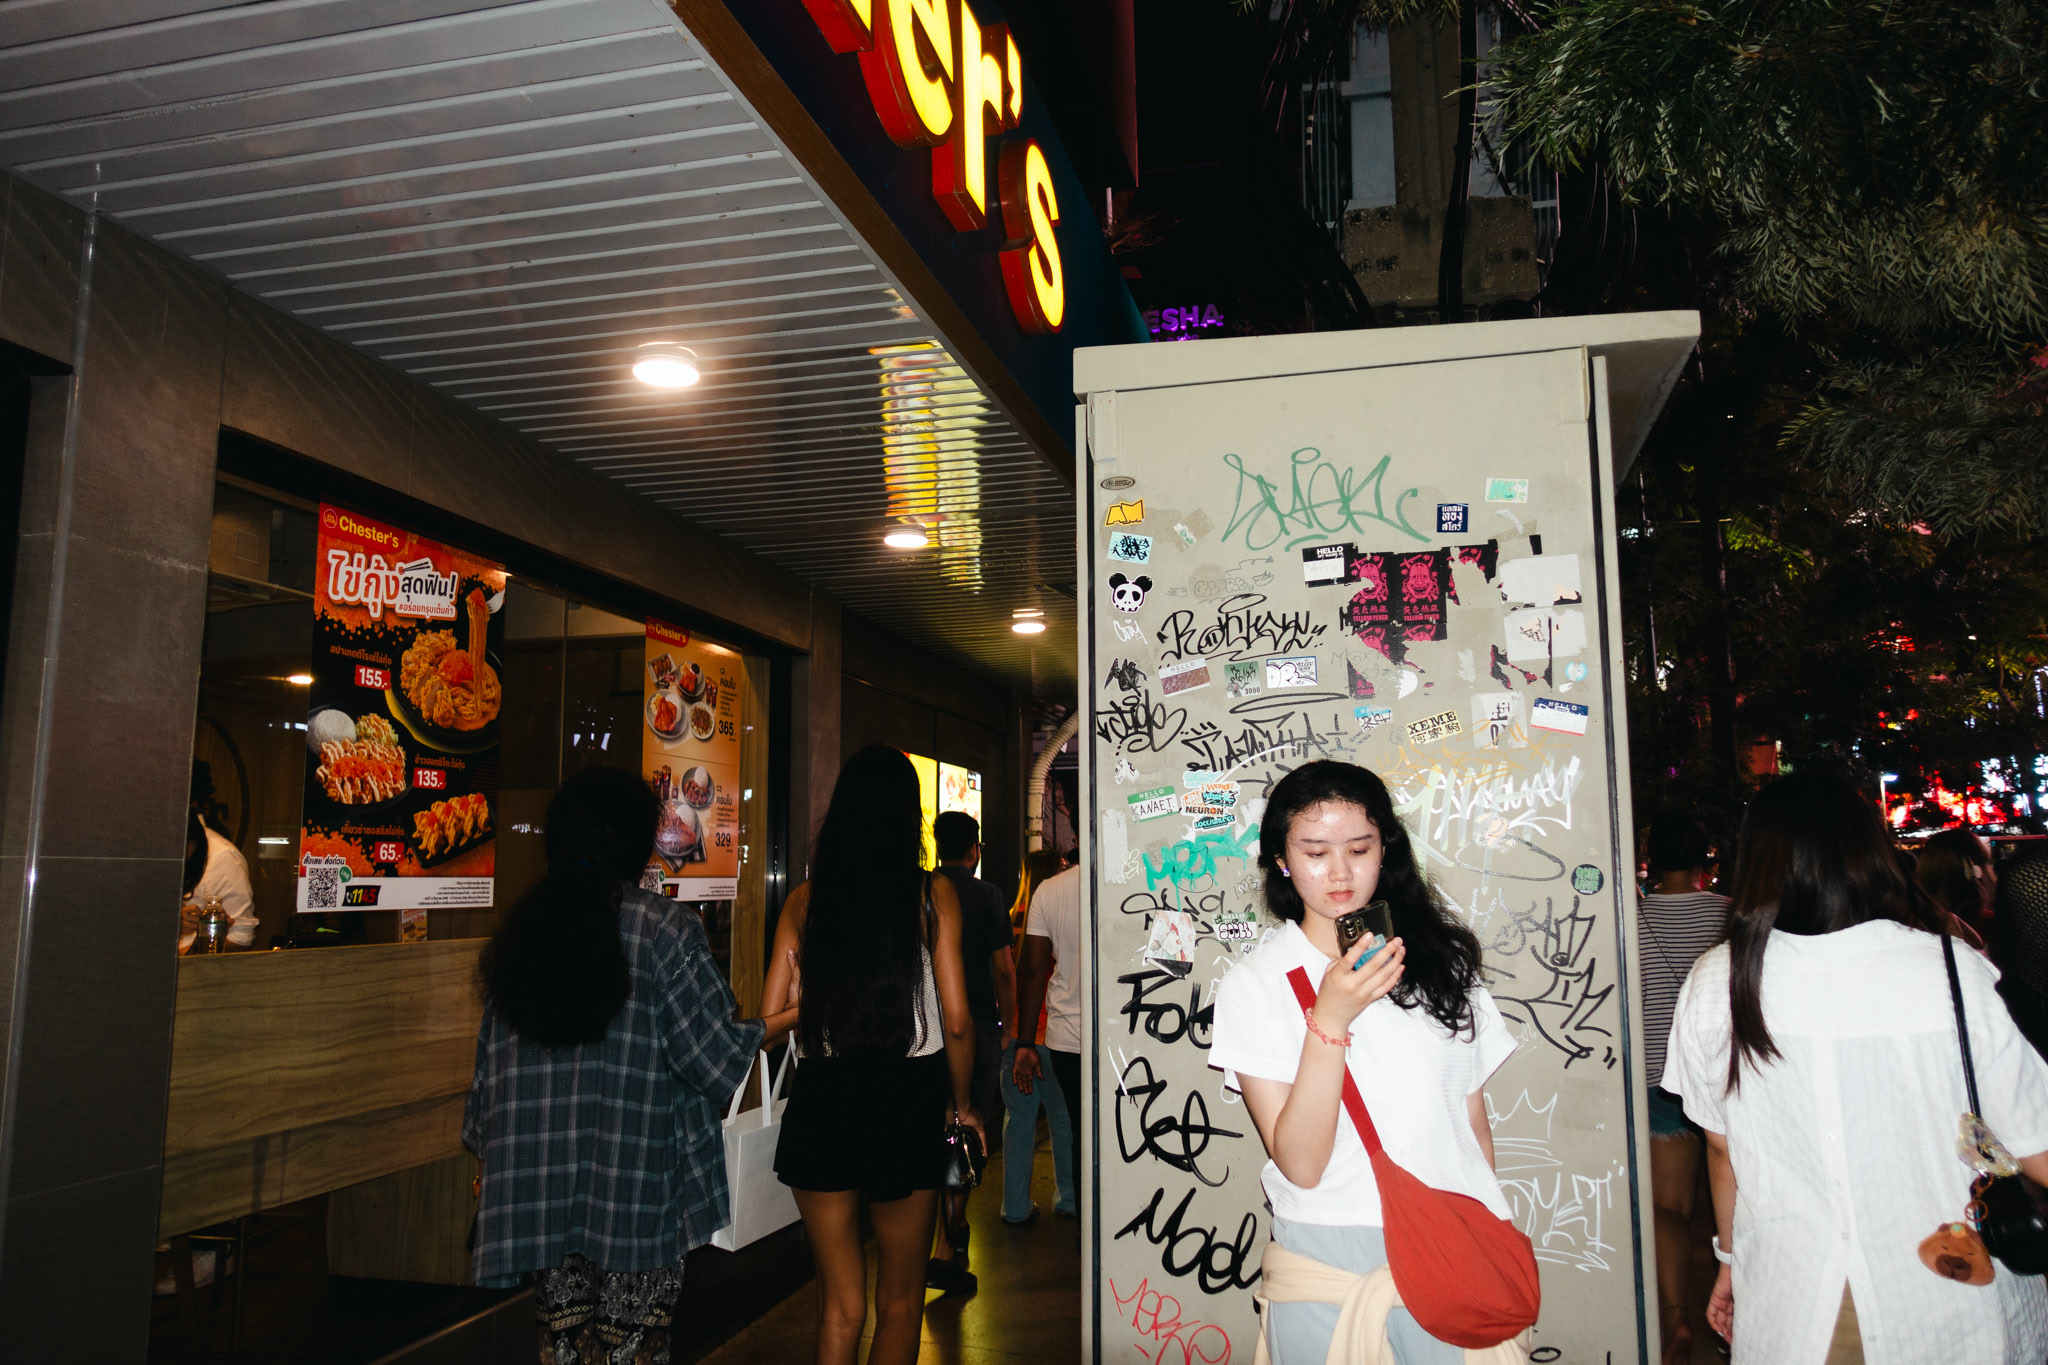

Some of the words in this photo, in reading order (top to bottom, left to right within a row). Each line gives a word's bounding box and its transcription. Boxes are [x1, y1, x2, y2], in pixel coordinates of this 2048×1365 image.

[339, 515, 399, 549] Chester's
[1316, 545, 1344, 555] HELLO
[655, 622, 686, 643] Chester's
[1170, 661, 1196, 673] HELLO
[359, 668, 388, 688] 155.-
[1244, 687, 1261, 695] 3000
[1548, 701, 1578, 711] HELLO
[1407, 711, 1457, 735] XEME
[417, 769, 443, 787] 135.-
[1139, 788, 1164, 800] HELLO
[1185, 806, 1224, 815] NEURON
[379, 843, 401, 861] 65.-
[352, 888, 377, 904] 1145
